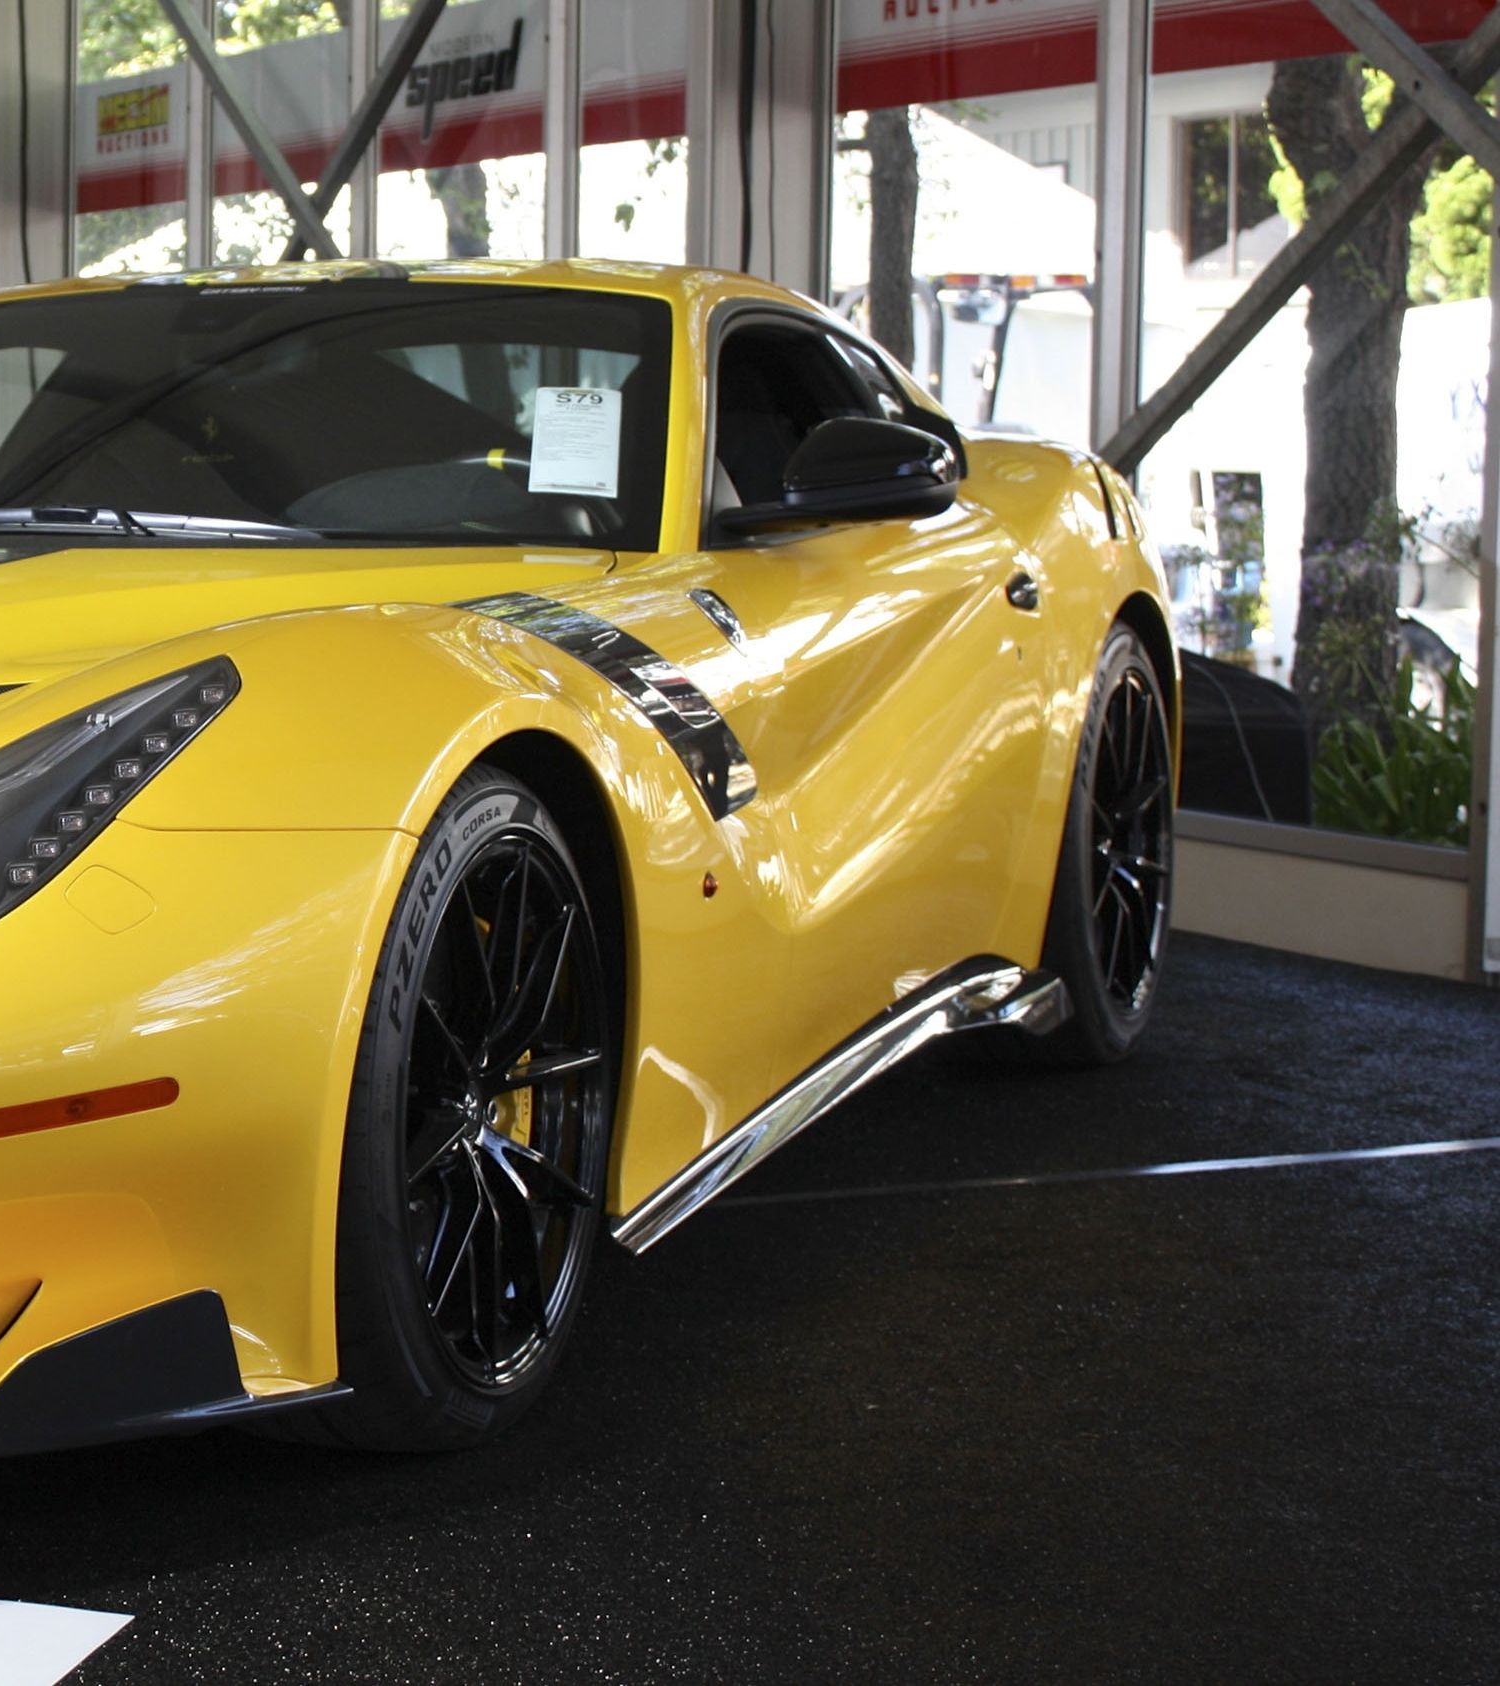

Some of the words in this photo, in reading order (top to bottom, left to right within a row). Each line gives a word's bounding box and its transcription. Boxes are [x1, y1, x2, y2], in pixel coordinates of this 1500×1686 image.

[405, 17, 523, 140] speed
[556, 393, 604, 405] S79
[462, 805, 501, 842] CORSA
